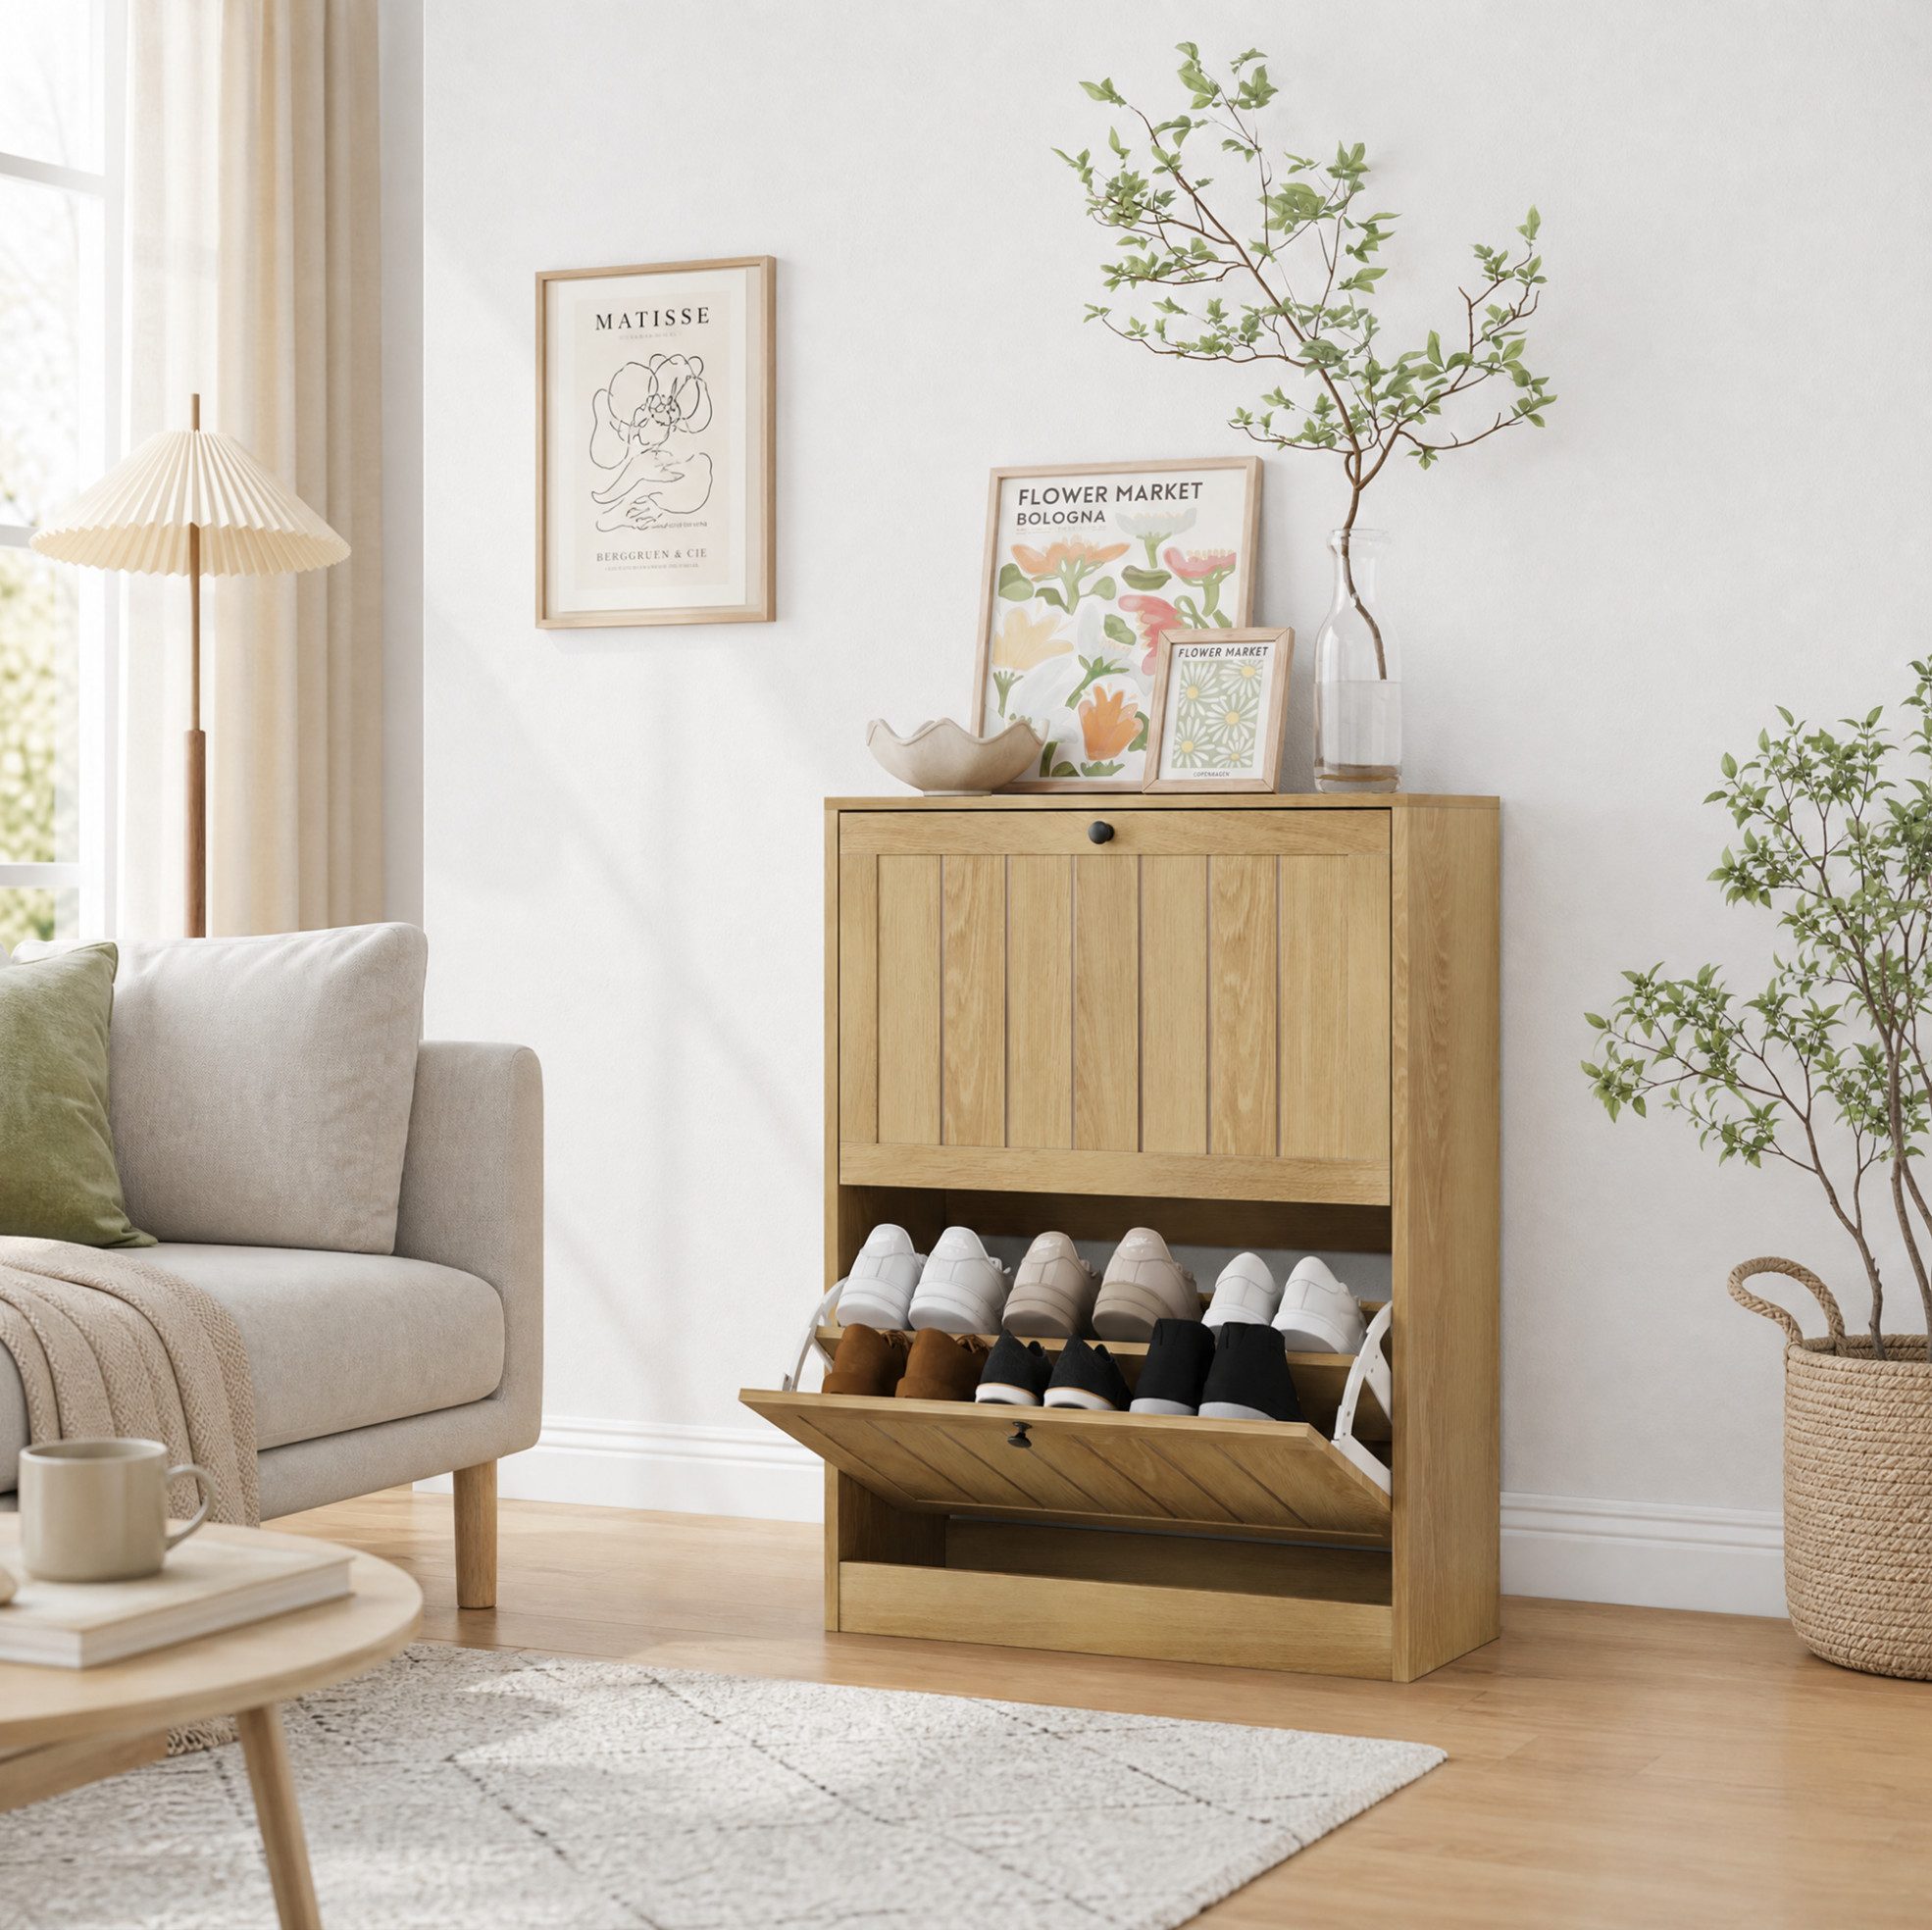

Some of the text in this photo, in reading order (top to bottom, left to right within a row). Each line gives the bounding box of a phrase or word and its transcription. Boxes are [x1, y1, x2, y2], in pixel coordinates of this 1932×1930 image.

[595, 306, 710, 330] MATISSE
[1018, 482, 1203, 506] FLOWER MARKET
[1016, 510, 1106, 526] BOLOGNA
[596, 548, 707, 562] BERGGRUEN & CIE
[1178, 646, 1269, 658] FLOWER MARKET
